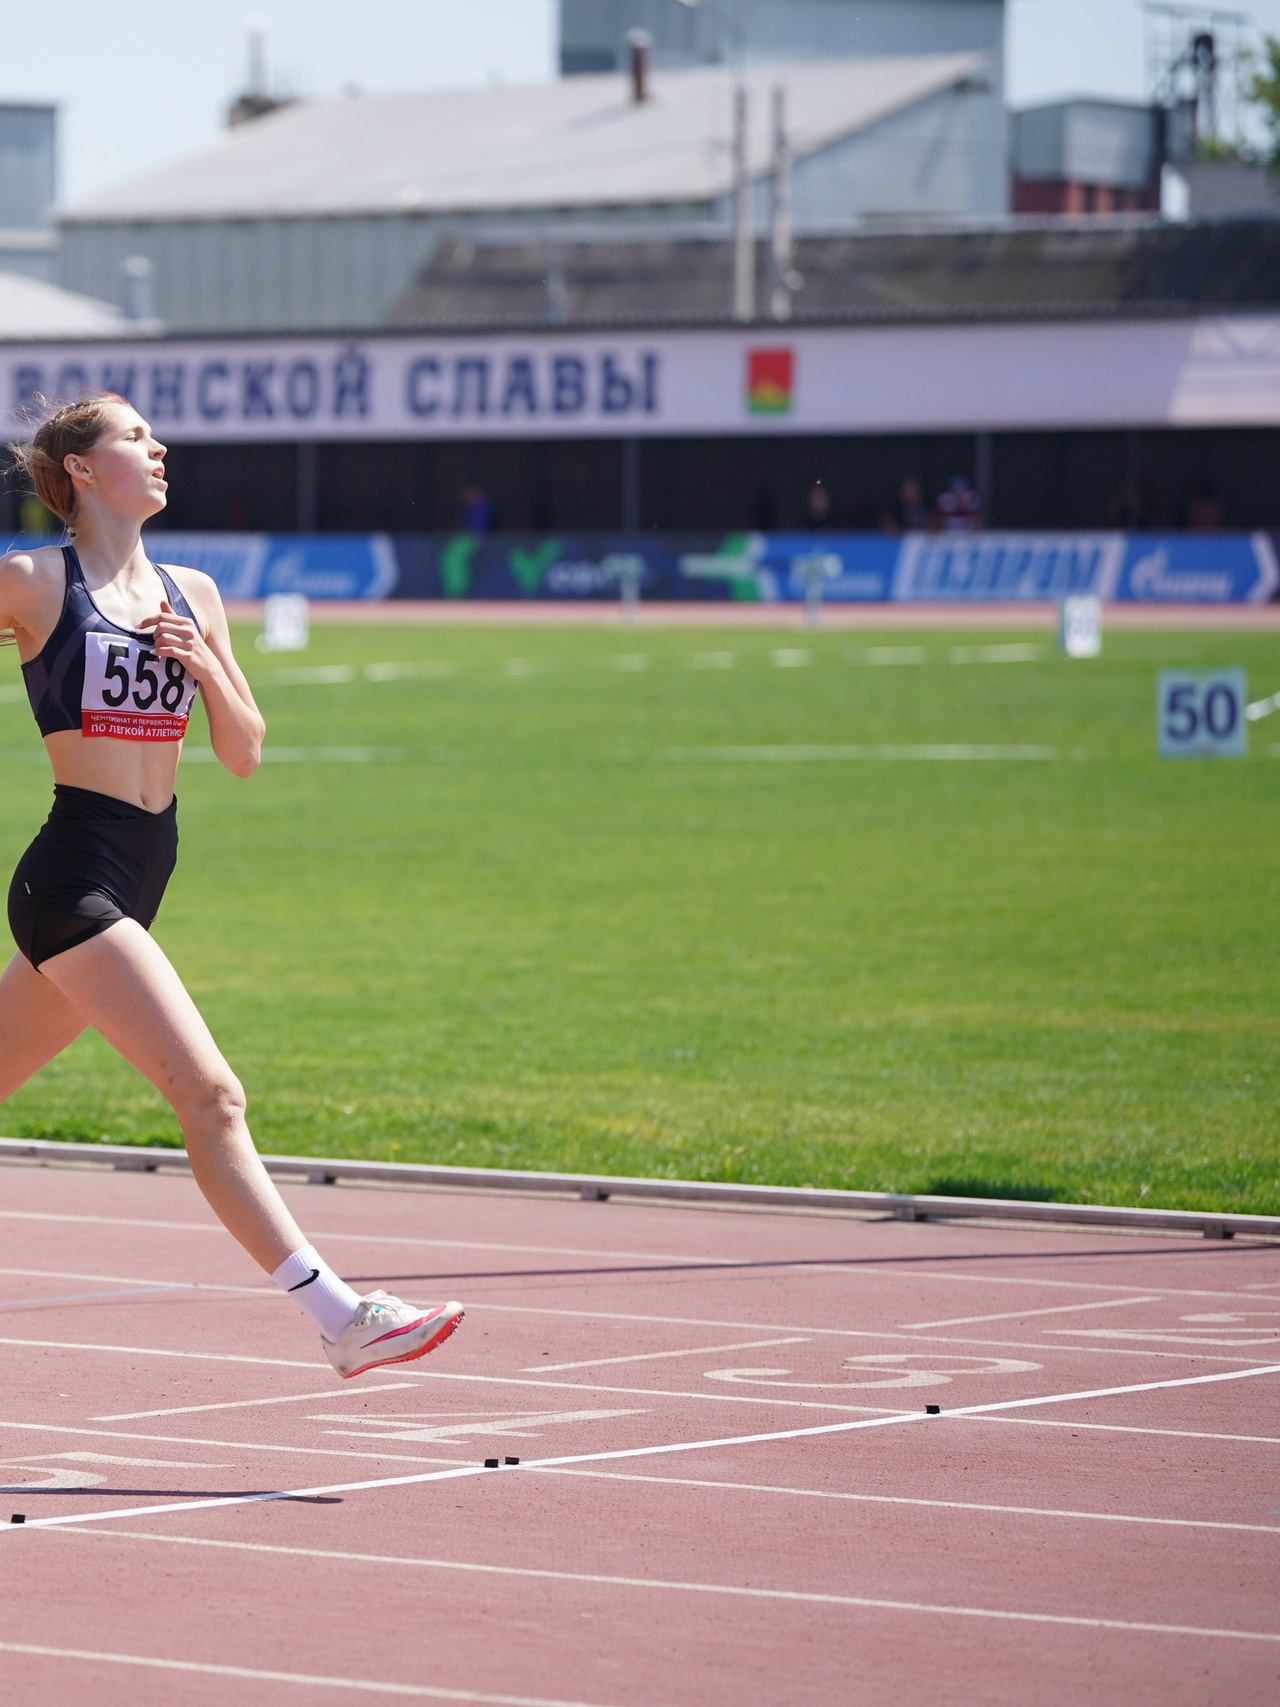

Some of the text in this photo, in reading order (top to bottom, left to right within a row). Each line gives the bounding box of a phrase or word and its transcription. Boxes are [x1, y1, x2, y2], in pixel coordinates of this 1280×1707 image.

[15, 344, 371, 424] ВОИНСКОЙ
[406, 350, 661, 420] СЛАВЫ
[101, 643, 187, 713] 558
[90, 715, 131, 724] ЧЕМПИОНАТ
[91, 723, 183, 737] ПО ЛЕГКОЙ АТЛЕТИКЕ
[1167, 683, 1237, 741] 50
